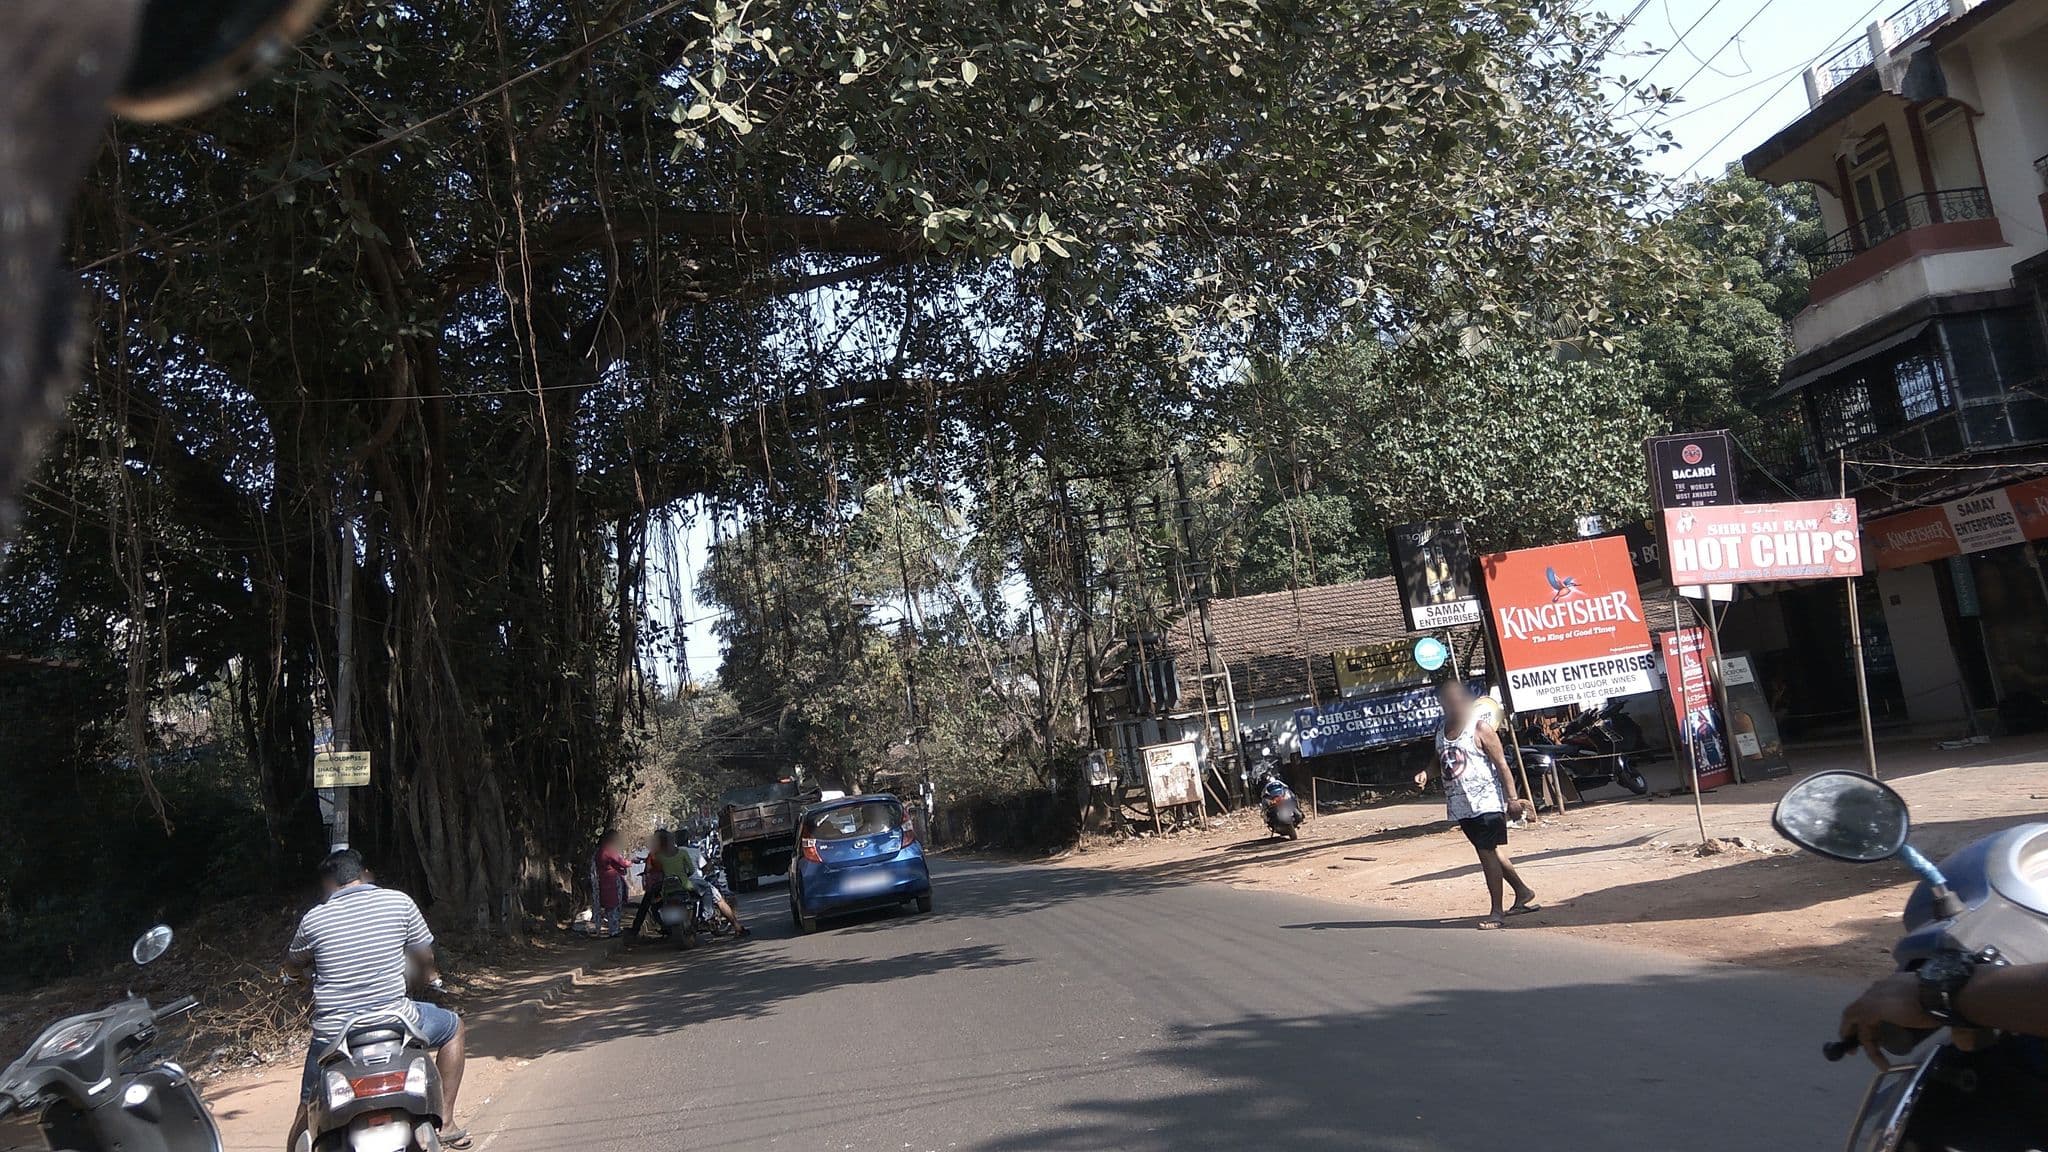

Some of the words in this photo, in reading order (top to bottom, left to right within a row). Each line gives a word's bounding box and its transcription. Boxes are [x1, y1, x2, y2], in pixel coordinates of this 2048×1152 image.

[1672, 463, 1716, 480] BACARDÍ
[1675, 492, 1691, 500] MOST
[1957, 496, 1996, 517] SAMAY
[1707, 523, 1747, 536] SHRI
[1751, 521, 1779, 534] SAI
[1784, 518, 1818, 531] RAM
[1954, 511, 2015, 537] ENTERPRISES
[1886, 520, 1952, 550] KINGFISHER
[1672, 536, 1743, 572] HOT
[1750, 529, 1857, 568] CHIPS
[1419, 612, 1480, 628] ENTERPRISES
[1426, 603, 1467, 617] SAMAY
[1499, 590, 1641, 640] KINGFISHER
[1532, 635, 1547, 644] The
[1547, 632, 1565, 642] King
[1565, 631, 1573, 639] of
[1573, 628, 1593, 637] Good
[1592, 625, 1617, 634] Times
[1511, 668, 1558, 690] SAMAY
[1563, 654, 1656, 682] ENTERPRISES
[1536, 683, 1577, 697] IMPORTED
[1579, 679, 1608, 690] LIQUOR
[1612, 675, 1637, 685] WINES
[1553, 694, 1575, 704] BEER
[1584, 691, 1596, 699] ICE
[1598, 686, 1627, 697] CREAM
[1317, 709, 1362, 726] SHREE
[1363, 698, 1418, 719] KALIKA
[1300, 725, 1344, 740] CO-OP.
[1346, 715, 1395, 732] CREDIT
[1399, 706, 1446, 723] SOCIET
